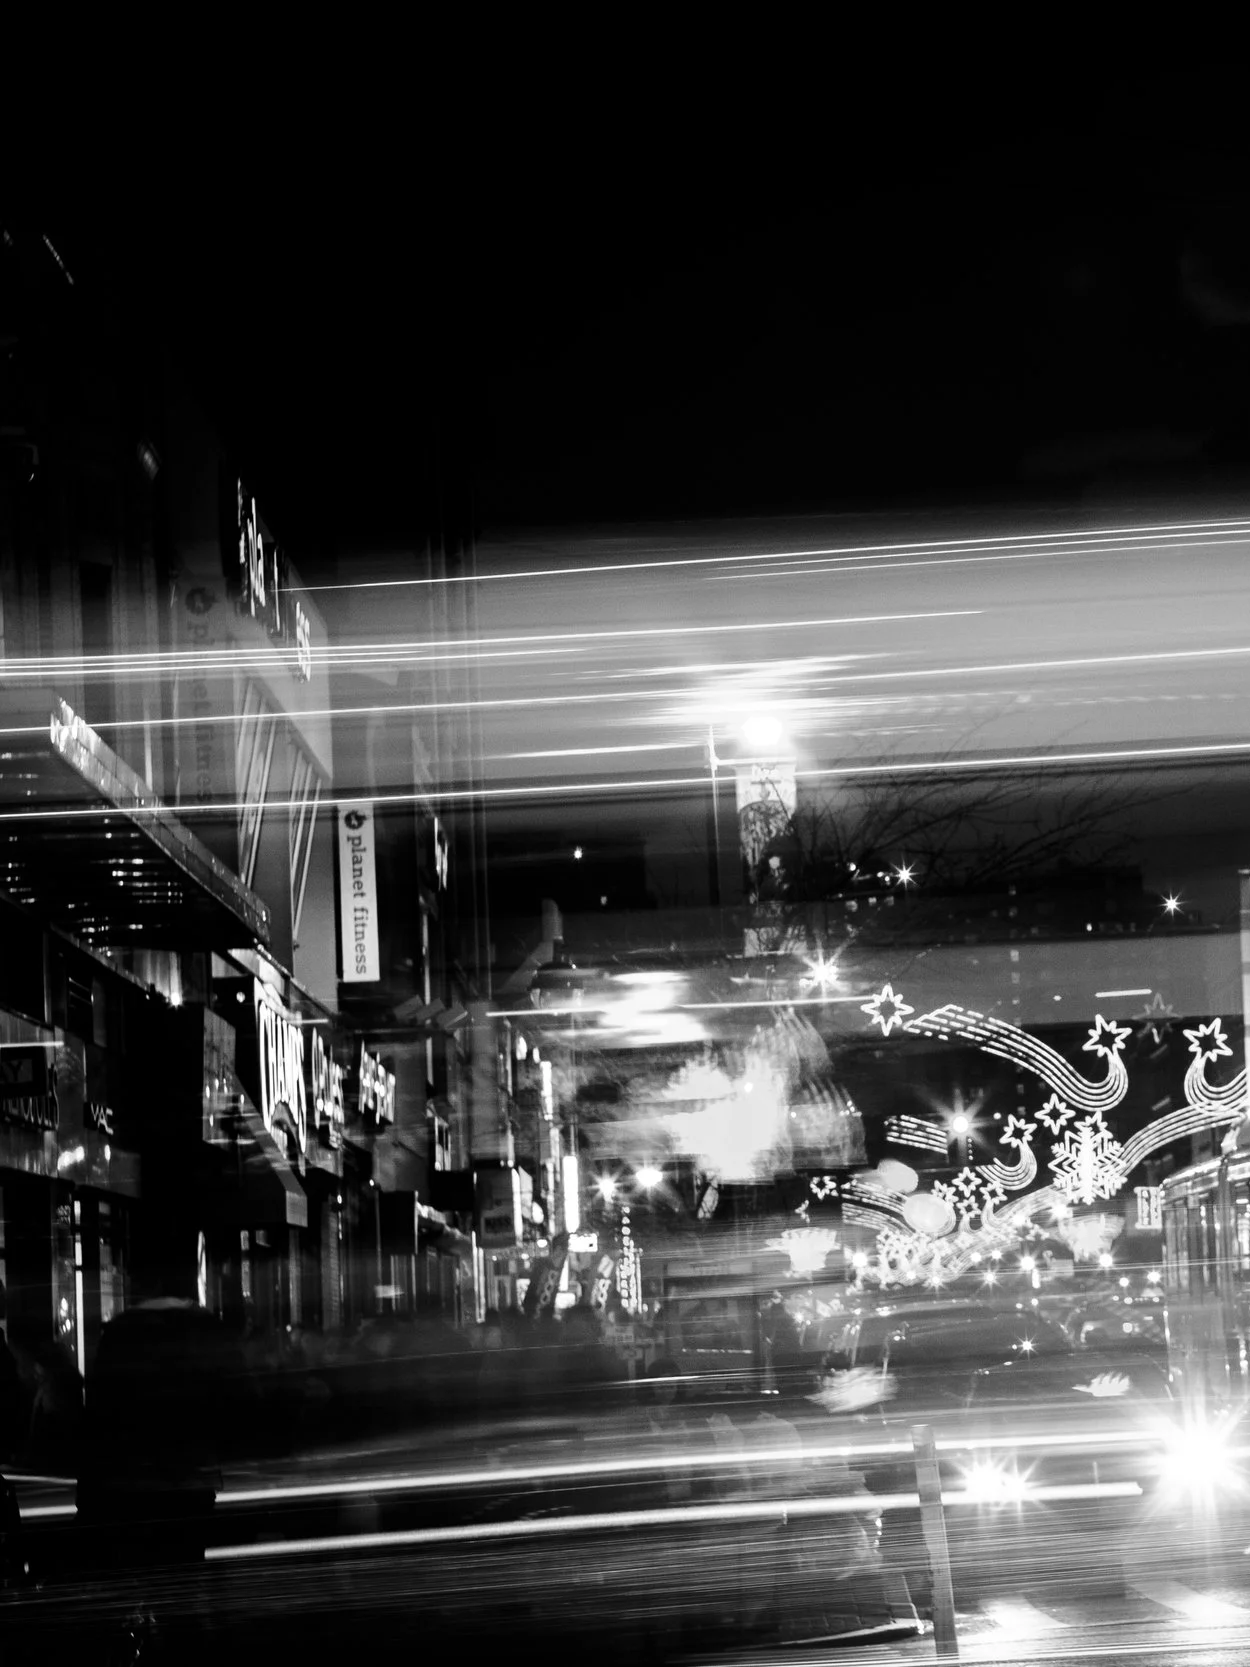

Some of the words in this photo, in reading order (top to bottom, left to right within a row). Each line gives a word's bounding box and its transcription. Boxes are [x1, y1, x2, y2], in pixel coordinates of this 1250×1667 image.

[347, 835, 367, 899] planet
[354, 906, 369, 975] fitness
[259, 1000, 307, 1154] CHAMPS
